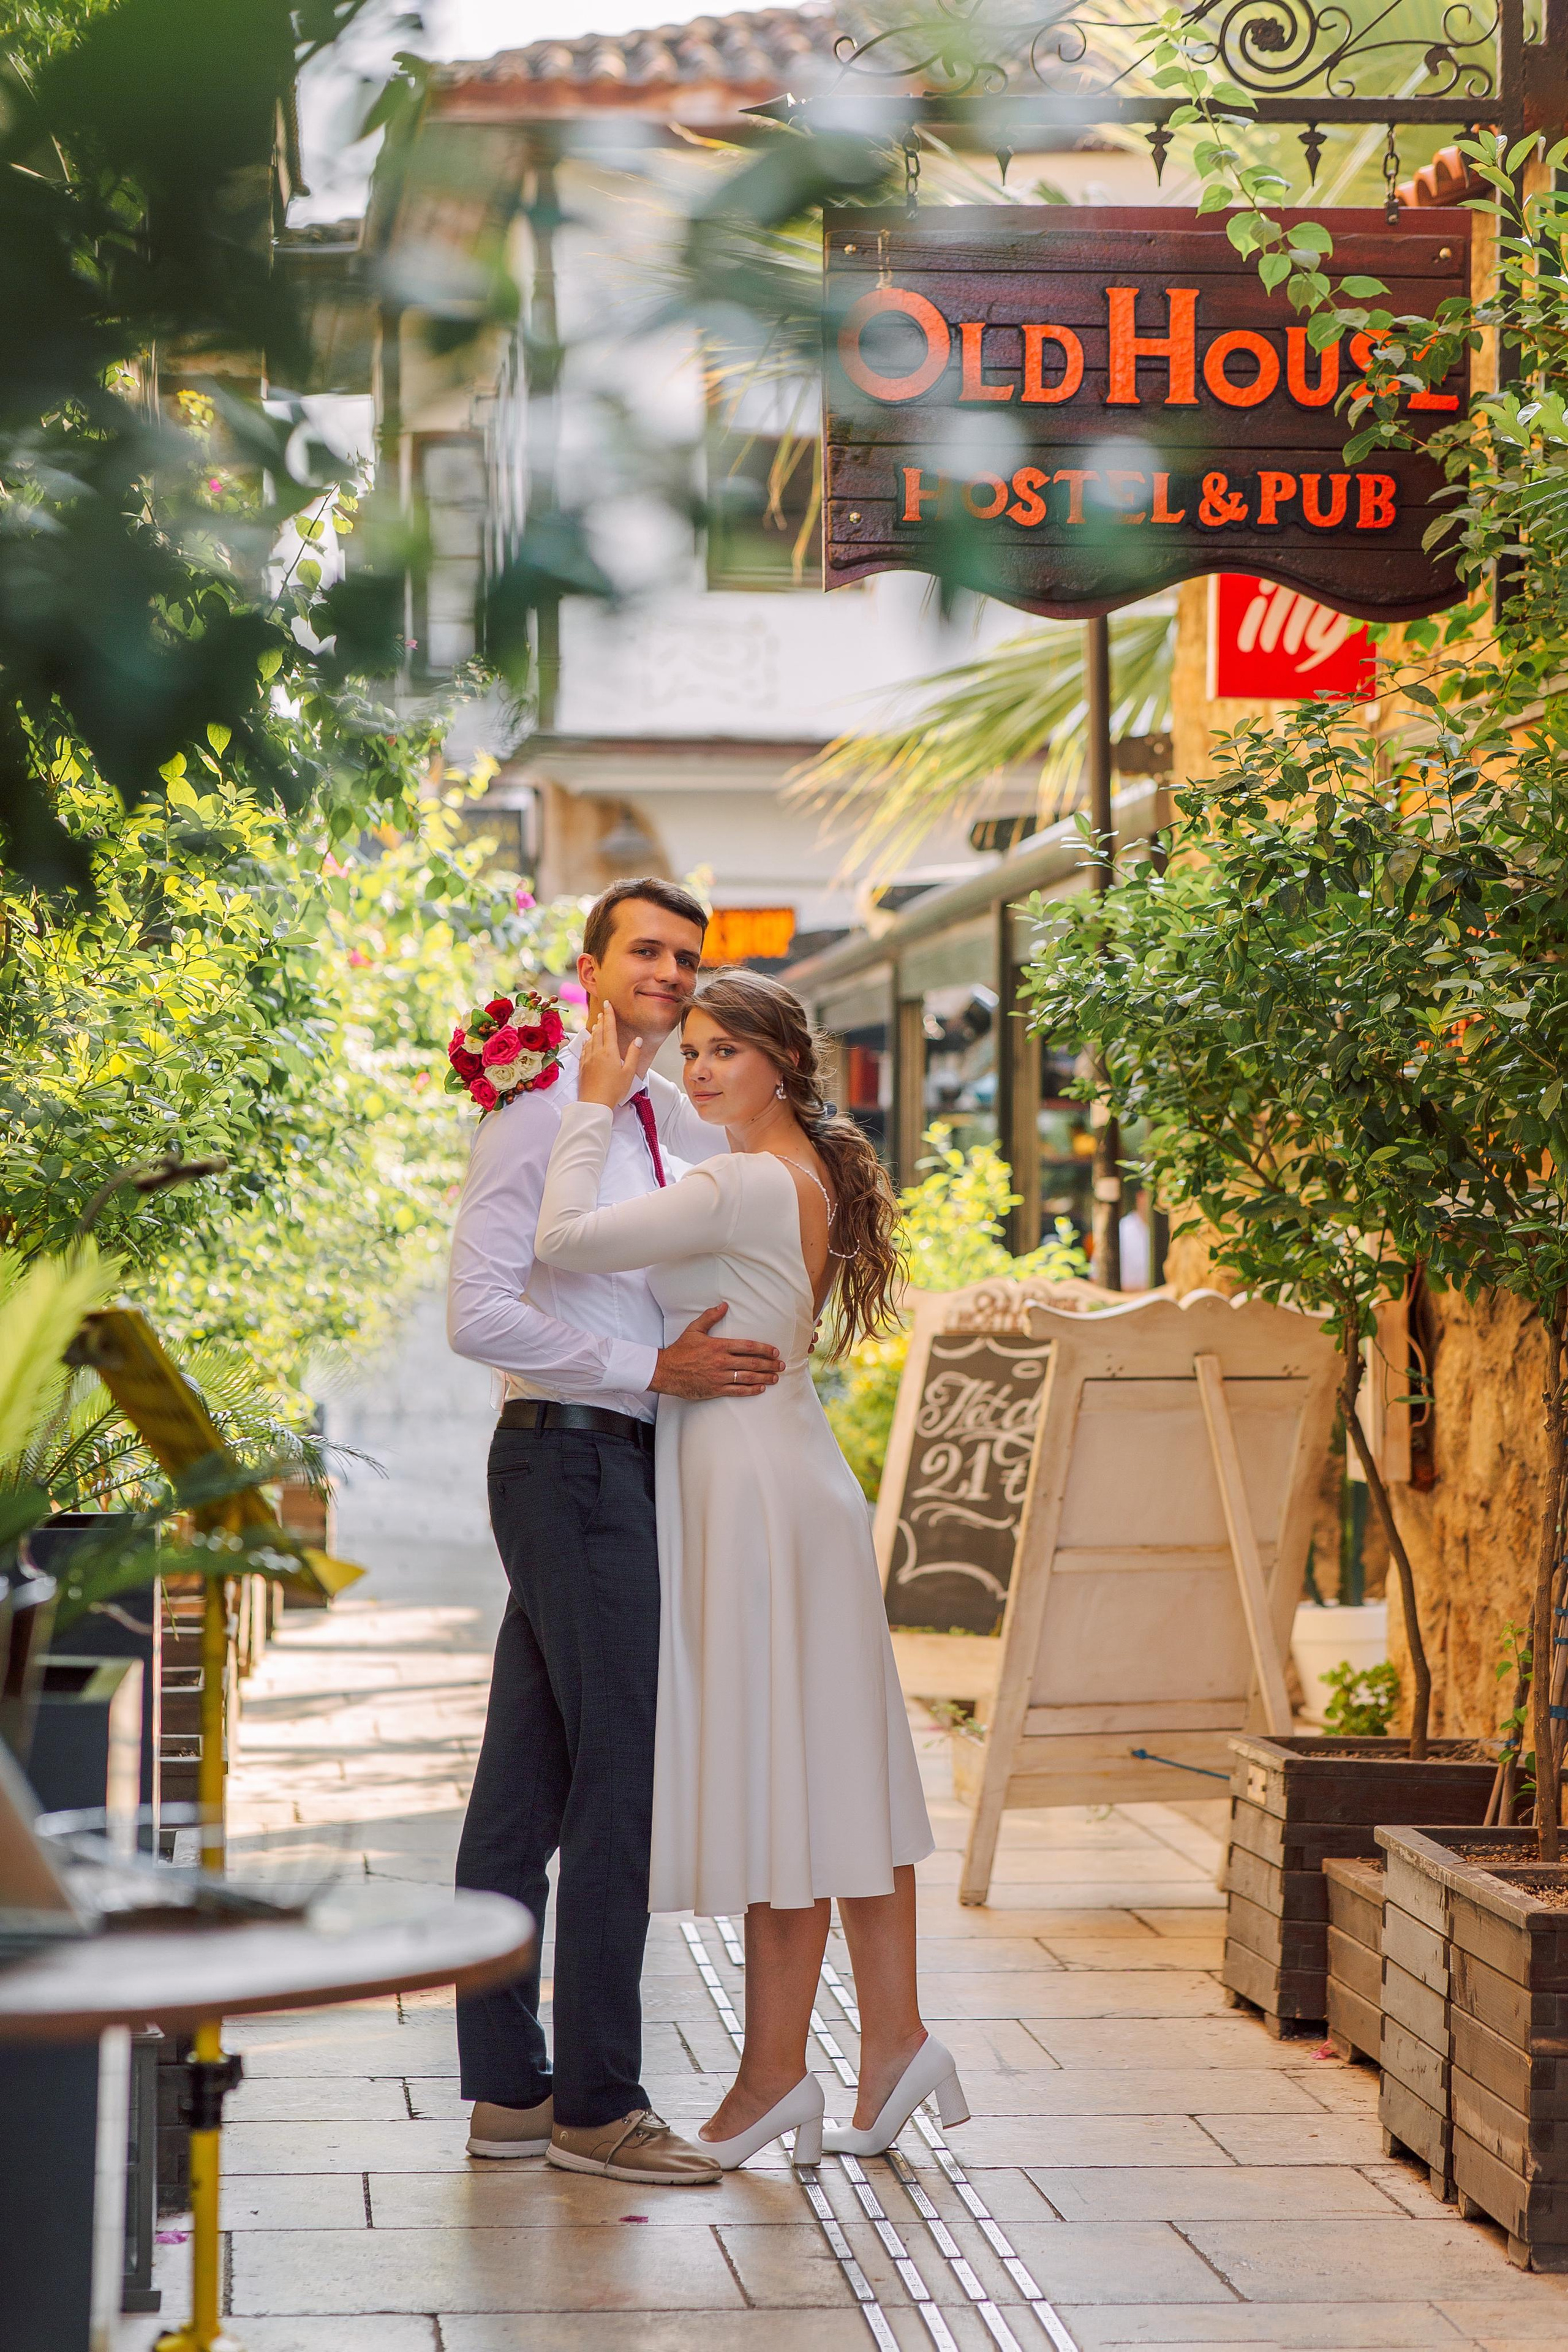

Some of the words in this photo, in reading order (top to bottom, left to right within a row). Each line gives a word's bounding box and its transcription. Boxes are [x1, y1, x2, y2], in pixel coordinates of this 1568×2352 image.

[837, 287, 1085, 403] OLD
[902, 466, 1186, 527] HOSTEL
[1198, 471, 1249, 526] &
[1257, 471, 1396, 529] PUB
[1237, 578, 1351, 673] illy
